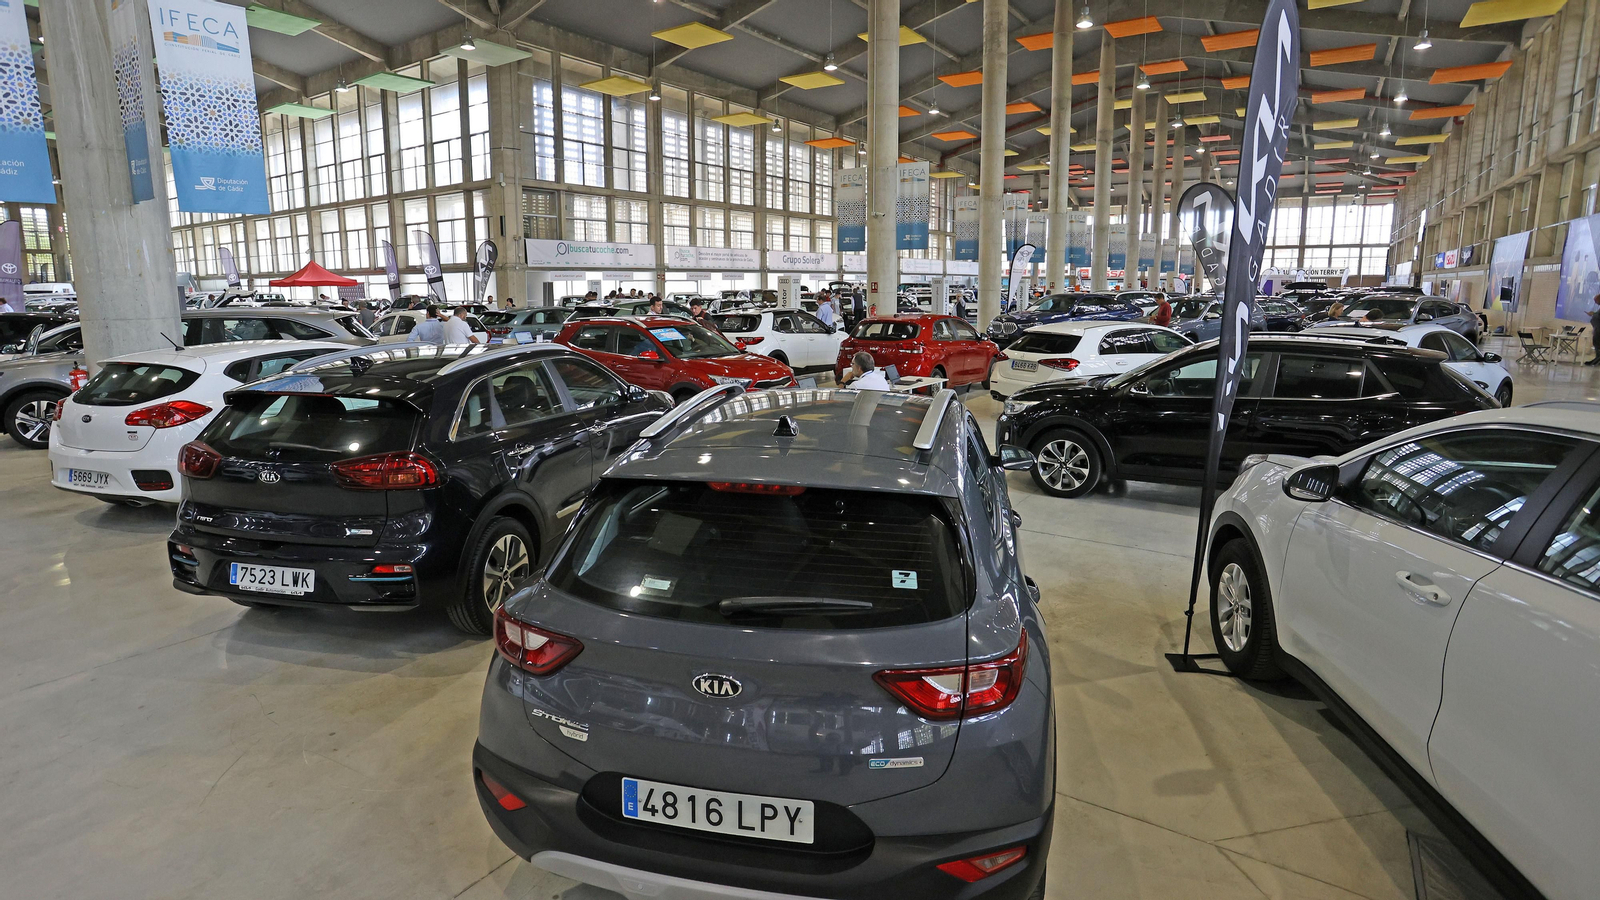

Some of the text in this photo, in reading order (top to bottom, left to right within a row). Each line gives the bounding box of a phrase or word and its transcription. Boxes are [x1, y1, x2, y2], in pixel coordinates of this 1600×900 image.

[160, 8, 238, 39] IFECA
[0, 168, 18, 176] ádiz
[900, 169, 926, 177] IFECA
[217, 177, 248, 185] Diputación
[840, 174, 863, 182] IFECA
[783, 255, 820, 265] Grupo Solera
[73, 470, 109, 485] 5669 JYX
[240, 566, 276, 585] 7523
[281, 570, 310, 588] LWK
[700, 678, 734, 695] KIA
[566, 730, 584, 739] hybrid
[628, 788, 802, 836] E 4816 LPY
